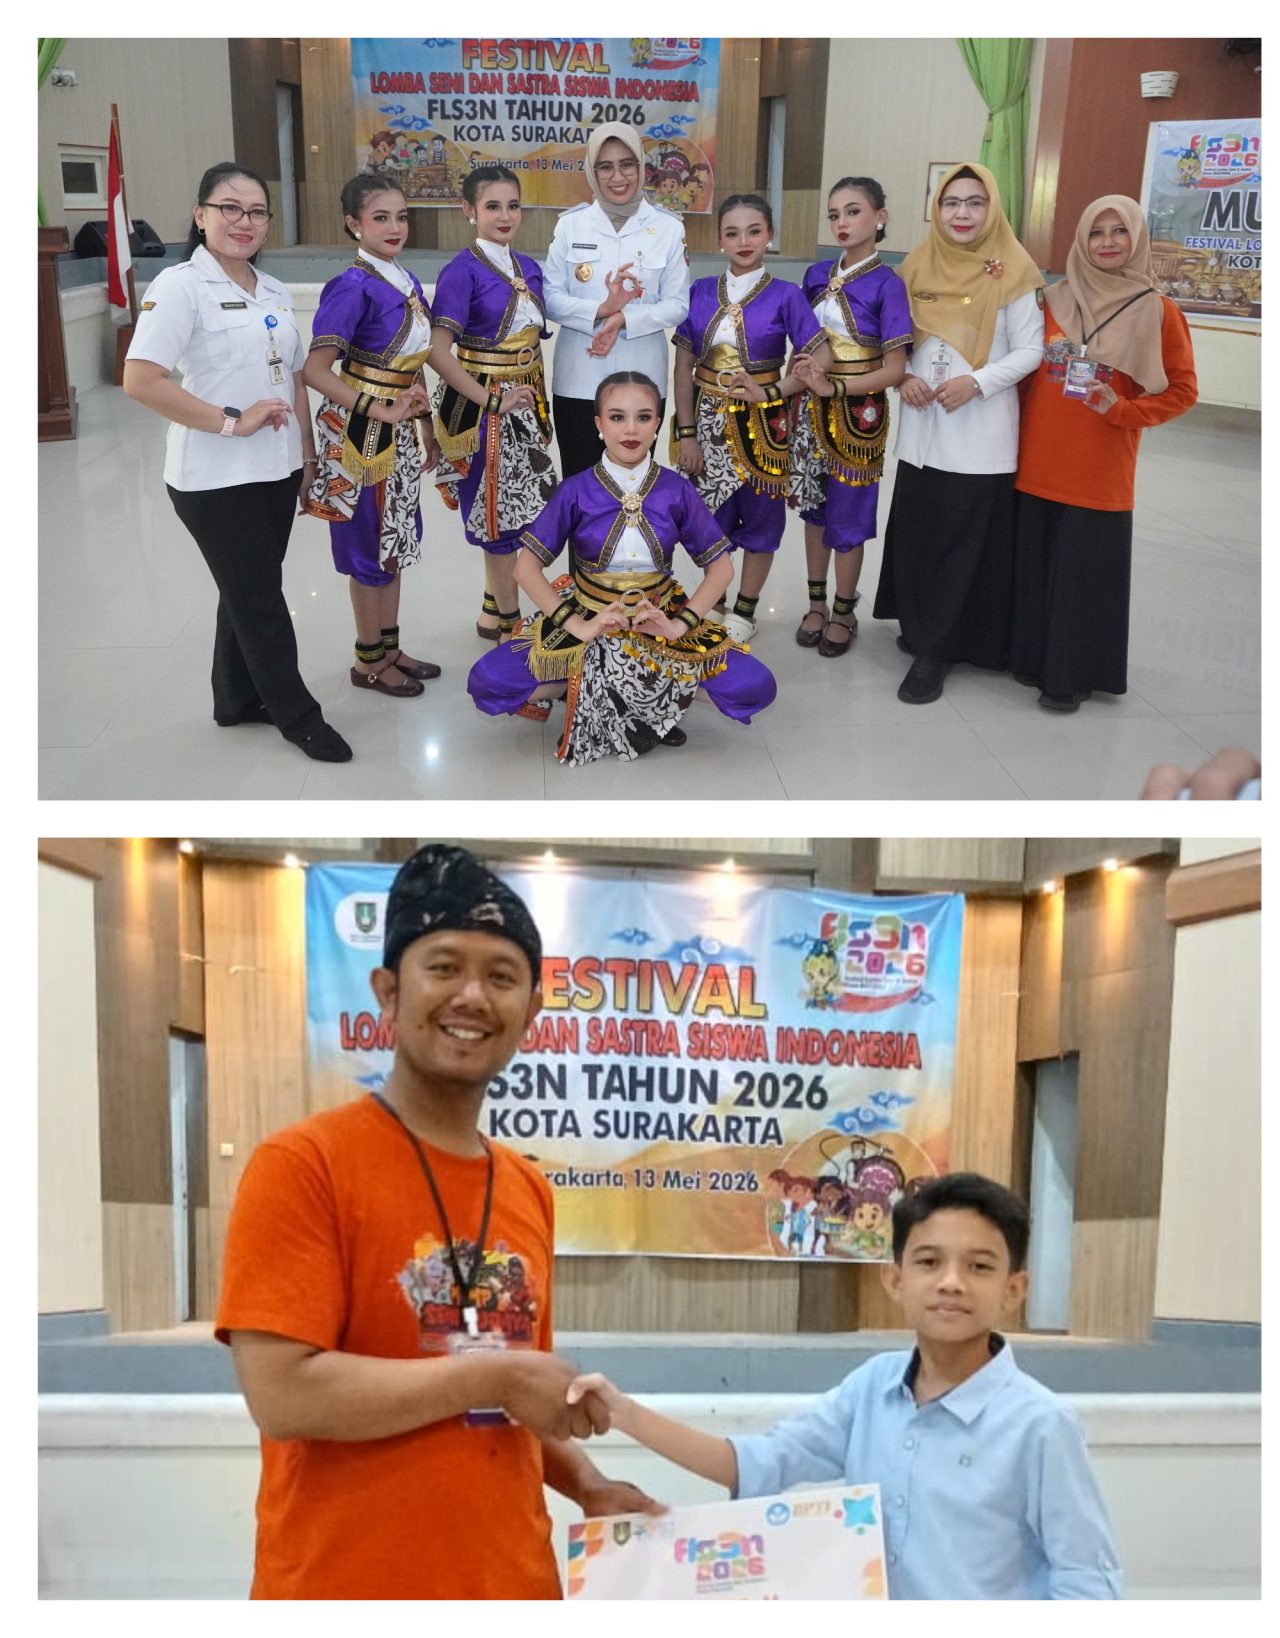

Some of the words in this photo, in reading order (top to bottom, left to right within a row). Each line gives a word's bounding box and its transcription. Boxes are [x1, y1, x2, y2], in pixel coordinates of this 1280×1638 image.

[462, 38, 611, 74] FESTIVAL
[370, 72, 426, 94] LOMBA
[429, 72, 465, 94] SENI
[469, 73, 503, 95] DAN
[507, 73, 560, 96] SASTRA
[564, 75, 611, 98] SISWA
[615, 78, 699, 103] INDONESIA
[427, 99, 496, 121] FLS3N
[505, 99, 582, 122] TAHUN
[591, 103, 645, 126] 2026
[453, 125, 505, 142] KOTA
[511, 125, 595, 144] SURAKA
[536, 159, 549, 170] 13
[552, 159, 573, 171] Mei
[1205, 153, 1258, 167] 2026
[1185, 237, 1241, 250] FESTIVAL
[541, 957, 768, 1020] ESTIVAL
[340, 1012, 396, 1051] LOM
[586, 1017, 680, 1058] SASTRA
[687, 1021, 769, 1064] SISWA
[776, 1027, 922, 1070] INDONESIA
[487, 1063, 568, 1101] S3N
[581, 1064, 719, 1106] TAHUN
[733, 1071, 828, 1111] 2026
[490, 1108, 582, 1138] KOTA
[593, 1110, 783, 1146] SURAKARTA
[547, 1167, 625, 1189] rakarta,
[634, 1168, 656, 1188] 13
[663, 1169, 701, 1191] Mei
[709, 1171, 759, 1192] 2026
